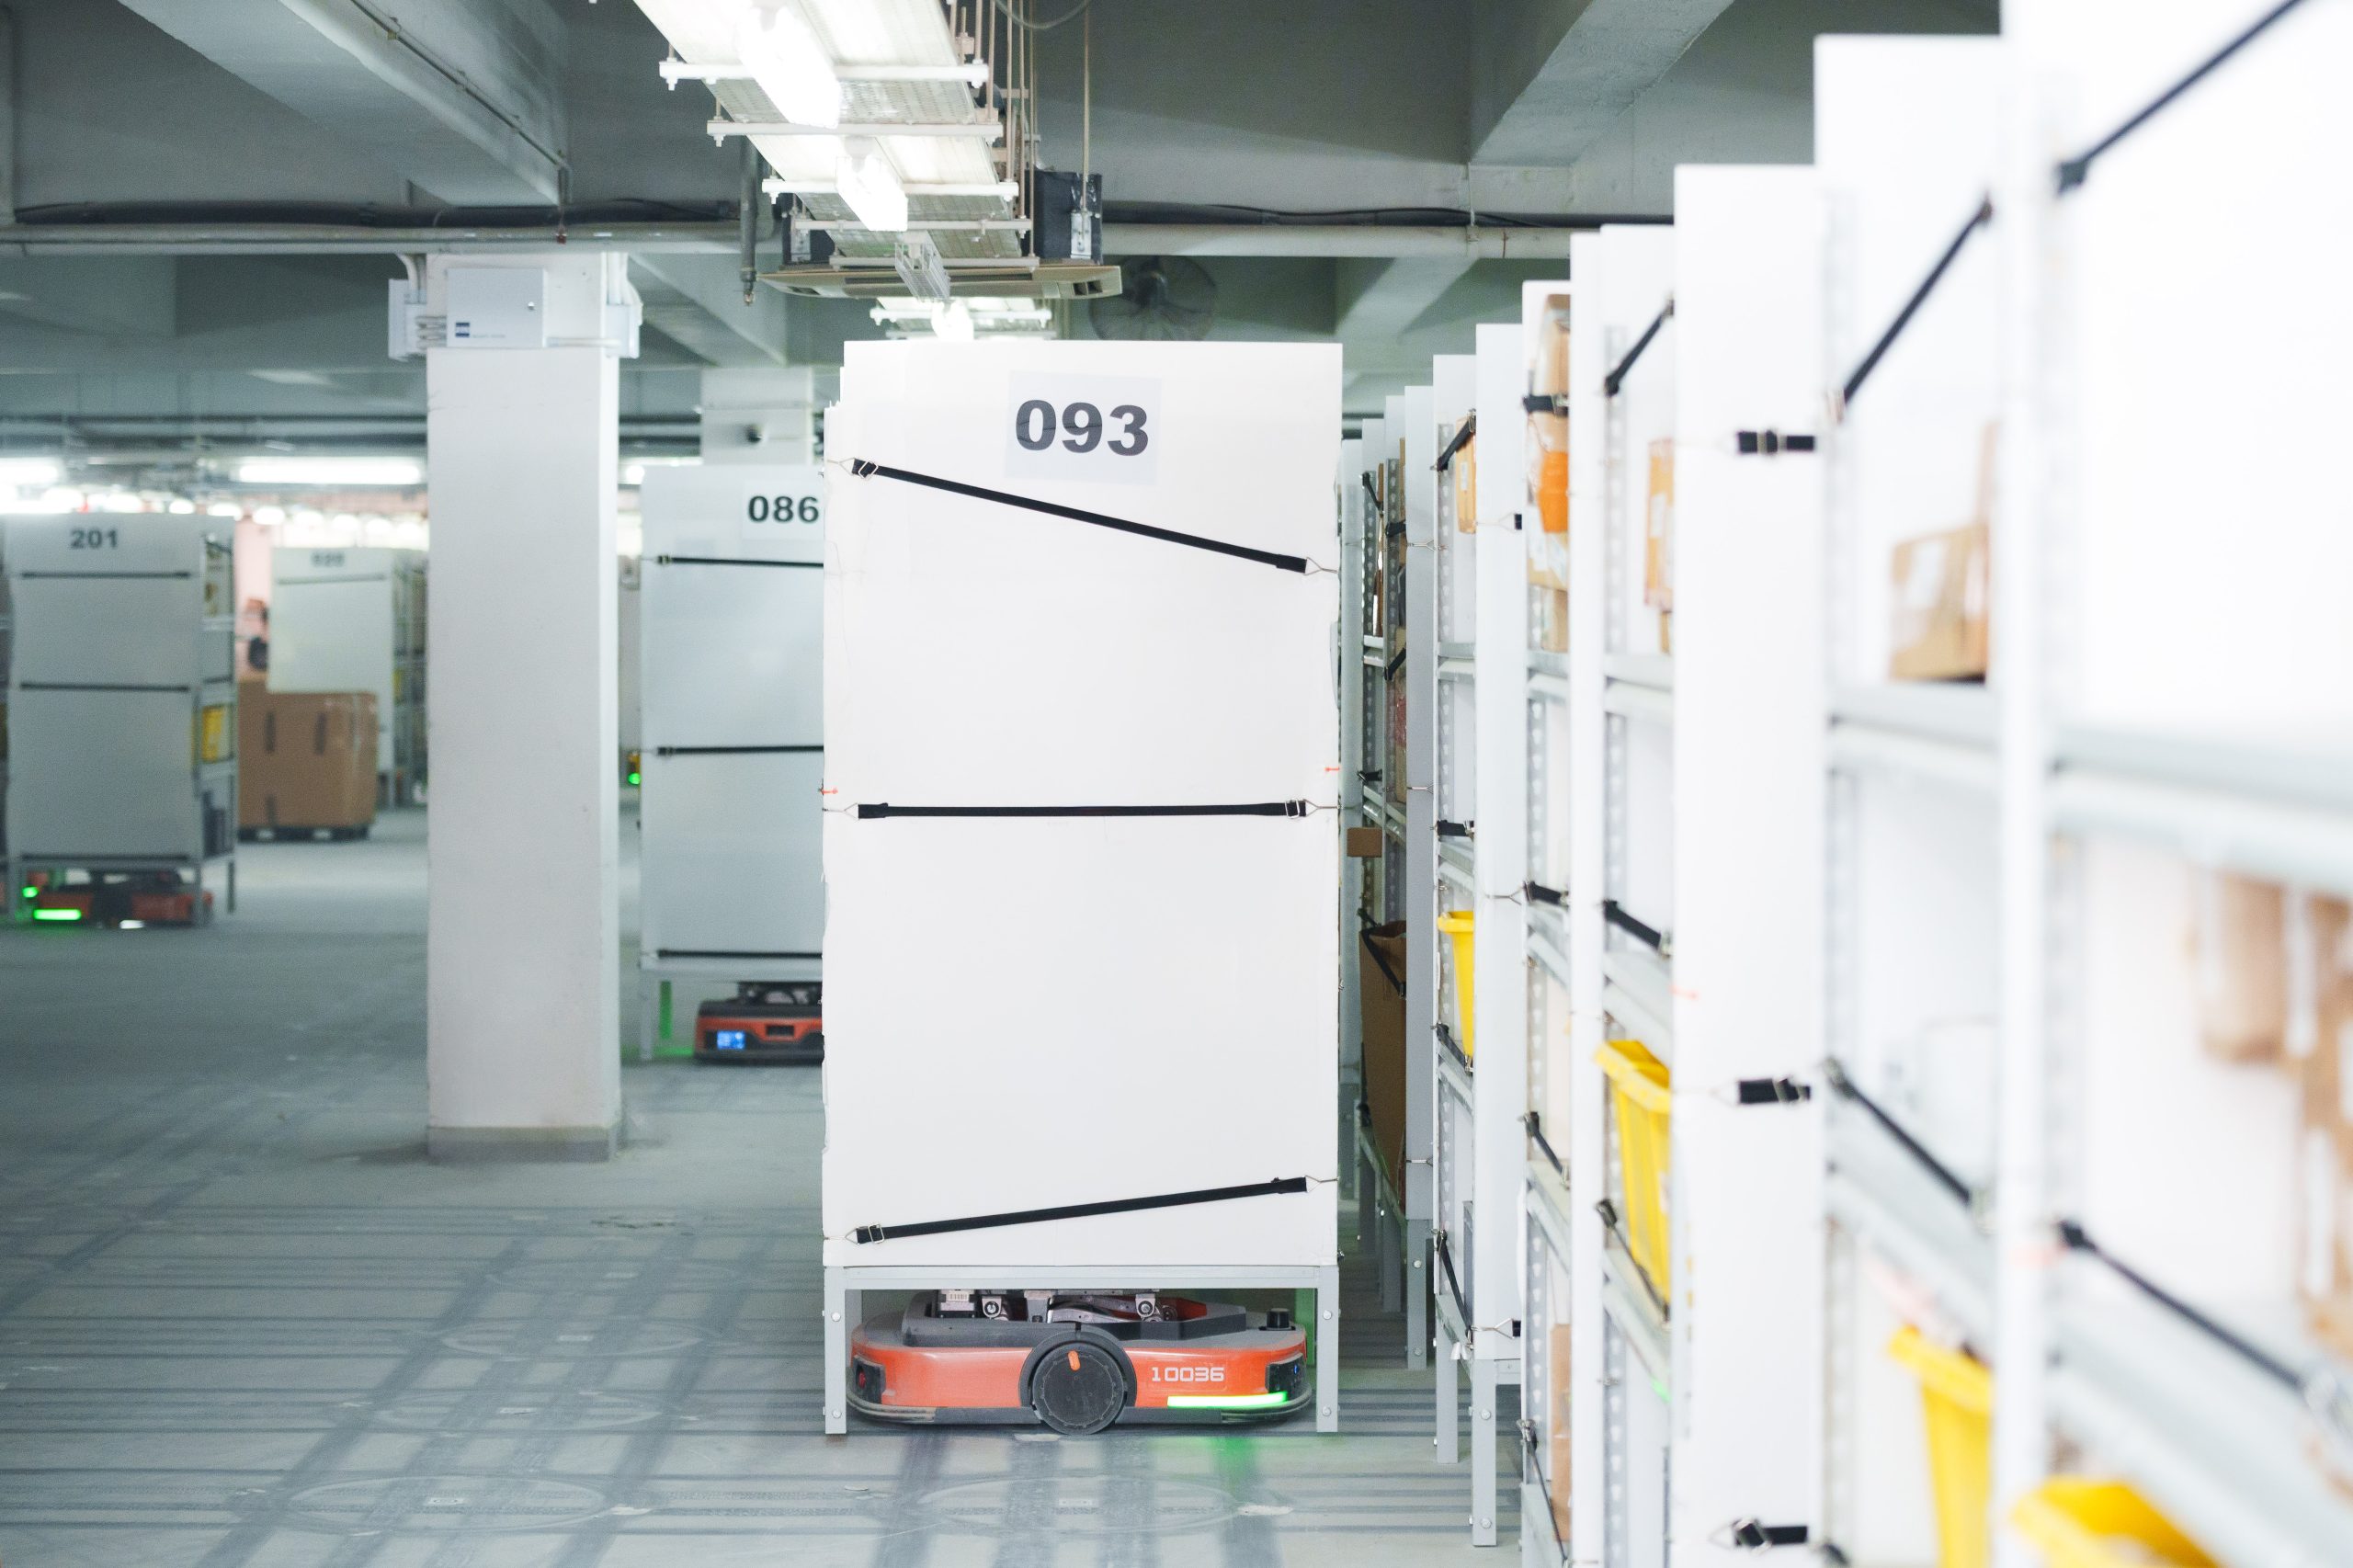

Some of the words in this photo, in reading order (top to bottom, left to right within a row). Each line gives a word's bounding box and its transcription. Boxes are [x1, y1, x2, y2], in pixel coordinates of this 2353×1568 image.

[1016, 399, 1149, 457] 093
[747, 495, 819, 523] 086
[70, 528, 118, 549] 201
[1152, 1367, 1225, 1382] 10036
